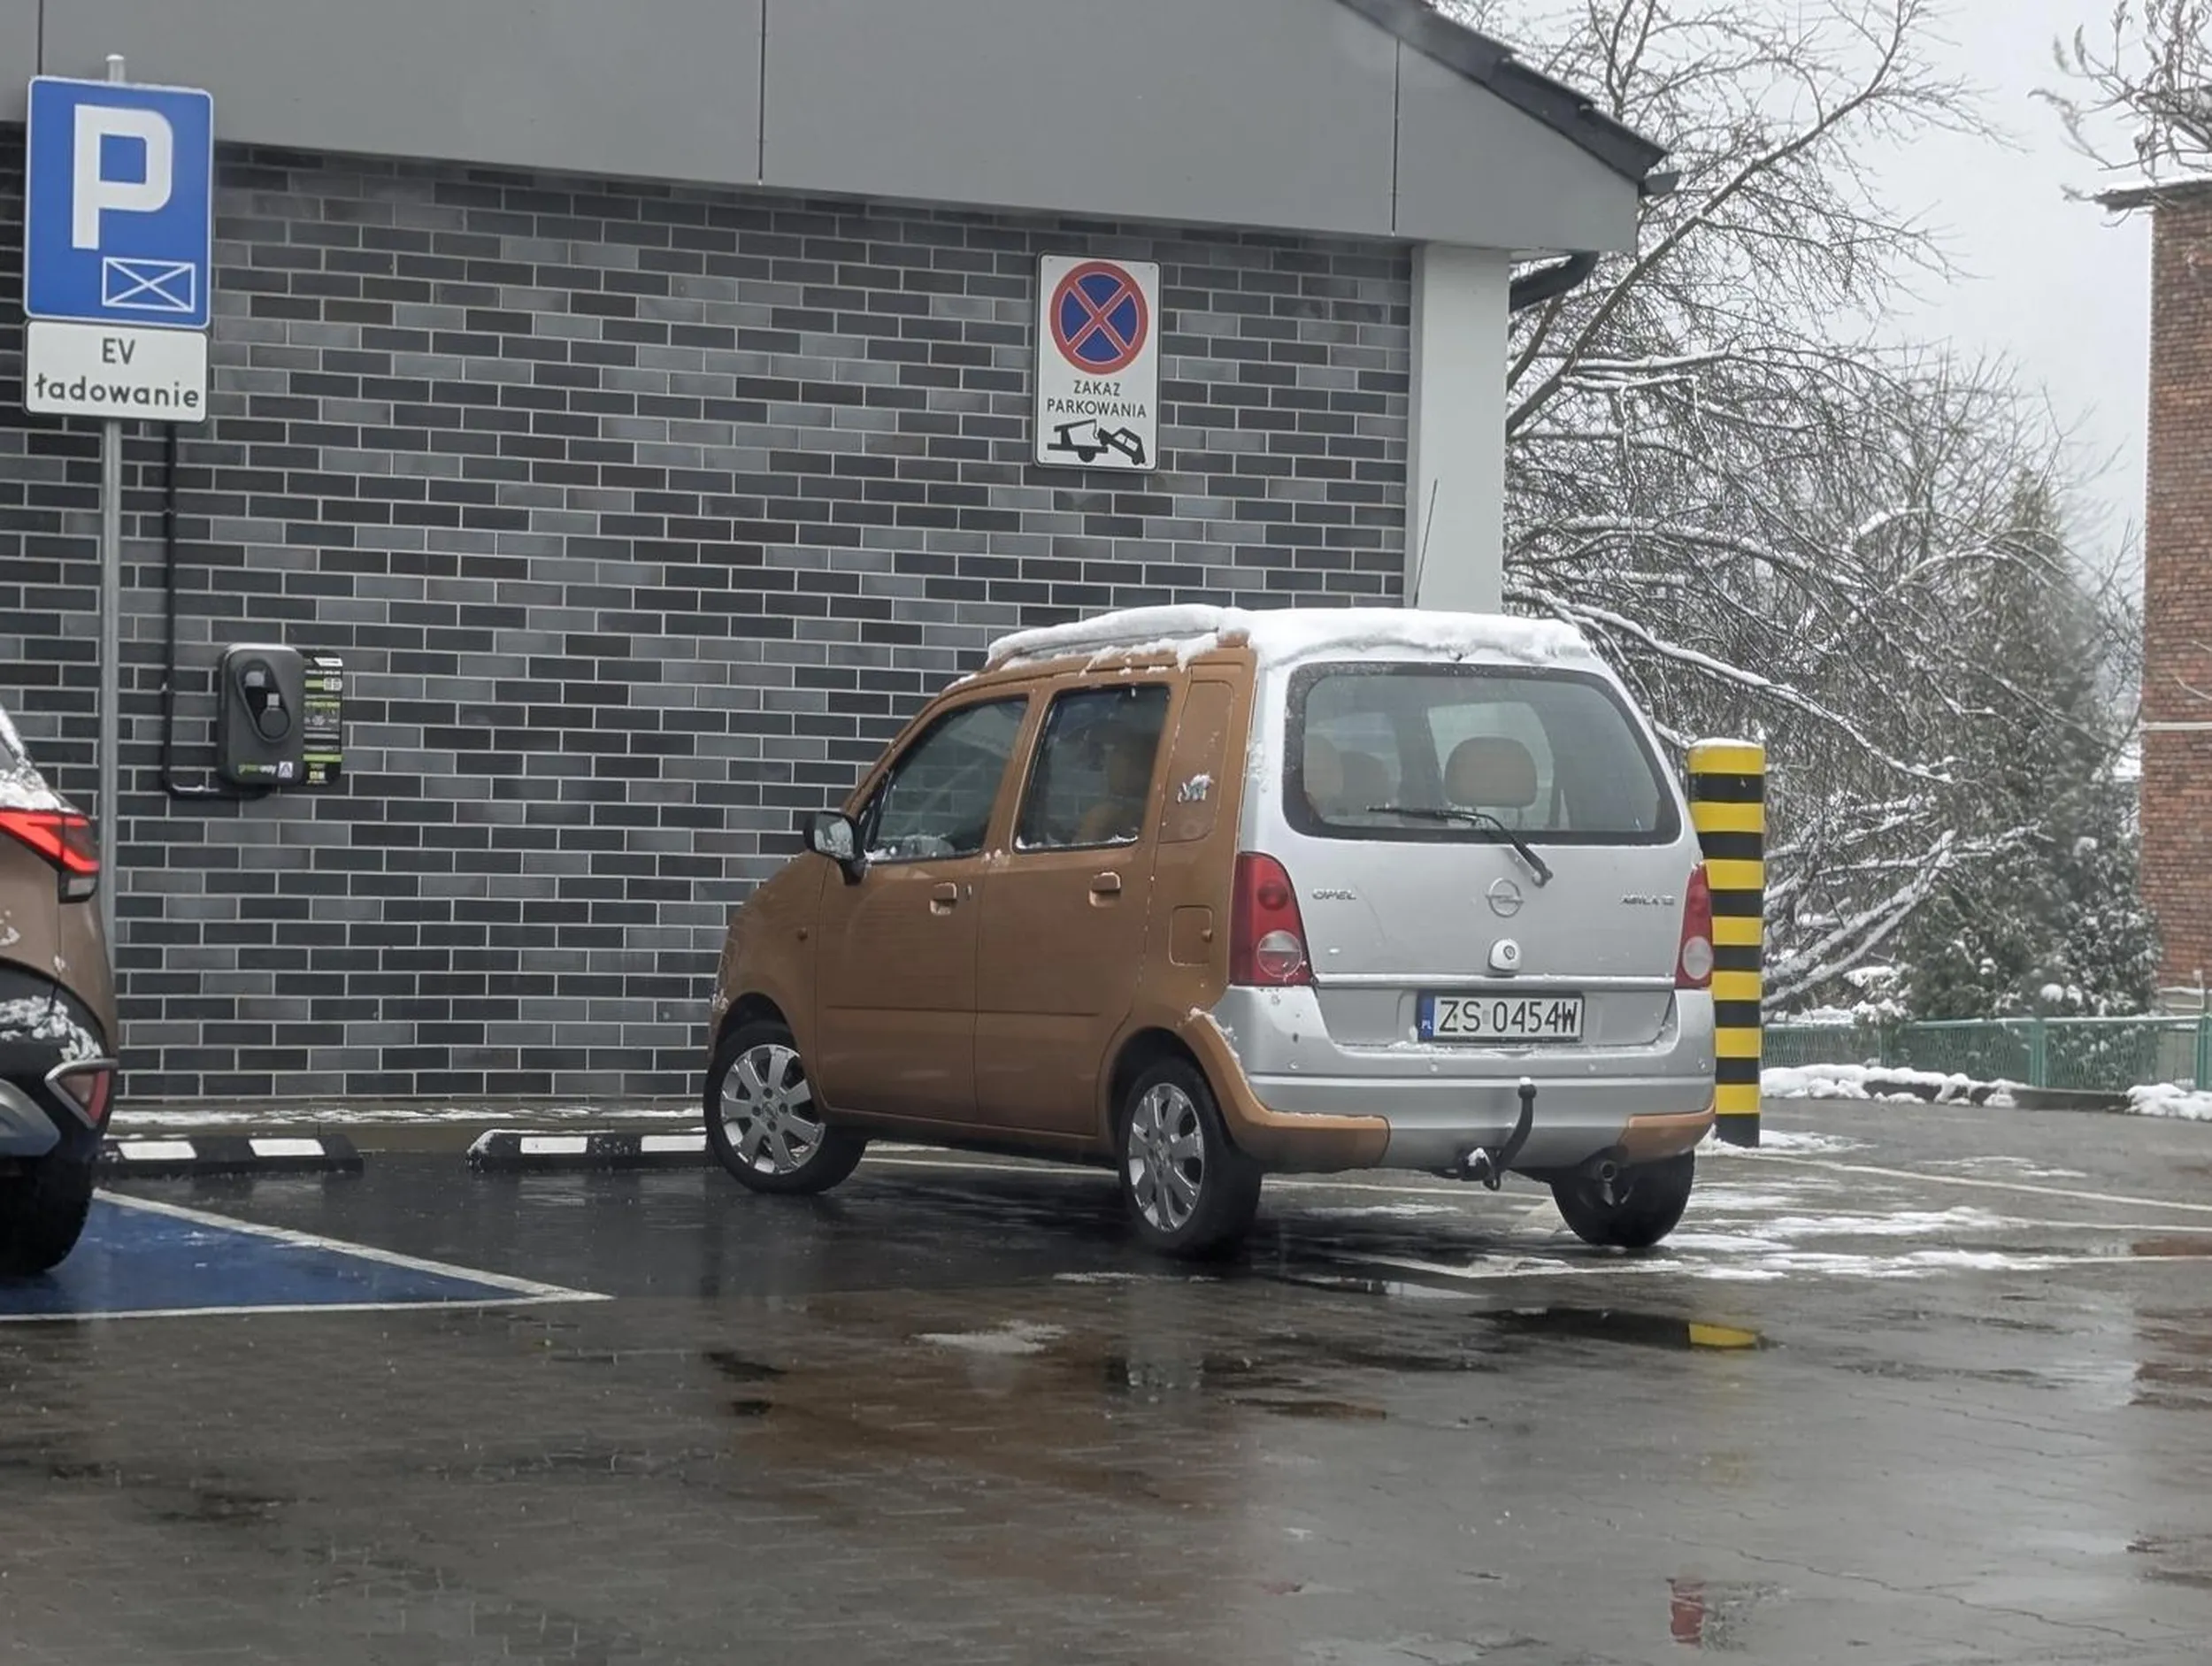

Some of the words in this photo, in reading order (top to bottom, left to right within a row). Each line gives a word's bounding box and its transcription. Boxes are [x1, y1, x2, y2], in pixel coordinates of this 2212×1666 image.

[72, 104, 173, 250] P
[102, 338, 135, 365] EV
[34, 372, 199, 409] ładowanie
[1072, 380, 1121, 396] ZAKAZ
[1047, 398, 1147, 418] PARKOWANIA
[1312, 889, 1356, 901] OPEL
[1421, 1020, 1432, 1030] PL
[1439, 1000, 1481, 1033] ZS
[1493, 1001, 1578, 1033] 0454W
